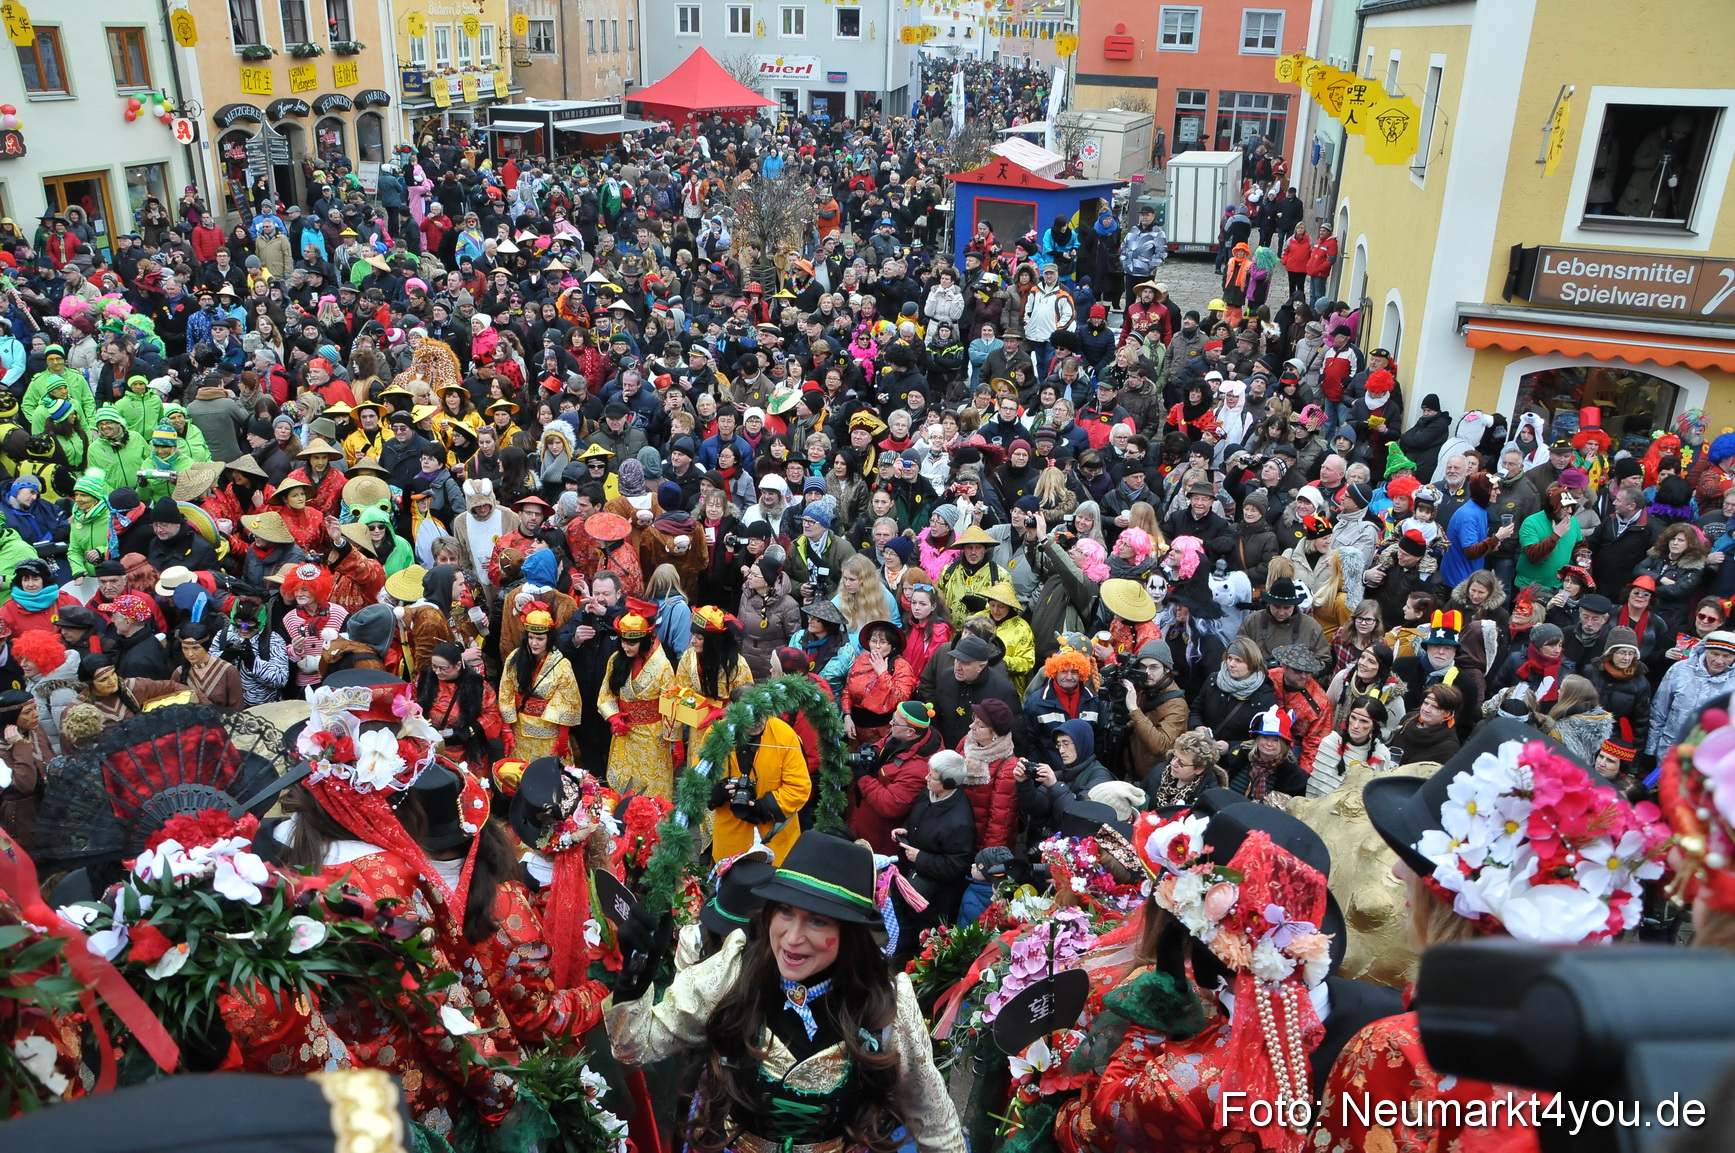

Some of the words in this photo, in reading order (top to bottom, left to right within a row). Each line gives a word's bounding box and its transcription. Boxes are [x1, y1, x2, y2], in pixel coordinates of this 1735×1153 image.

[321, 95, 353, 113] FEINKOST
[365, 90, 387, 104] IMBISS
[224, 105, 263, 126] METZGEREI
[561, 109, 589, 120] IMBISS
[1543, 255, 1695, 285] Lebensmittel
[1559, 282, 1687, 309] Spielwaren
